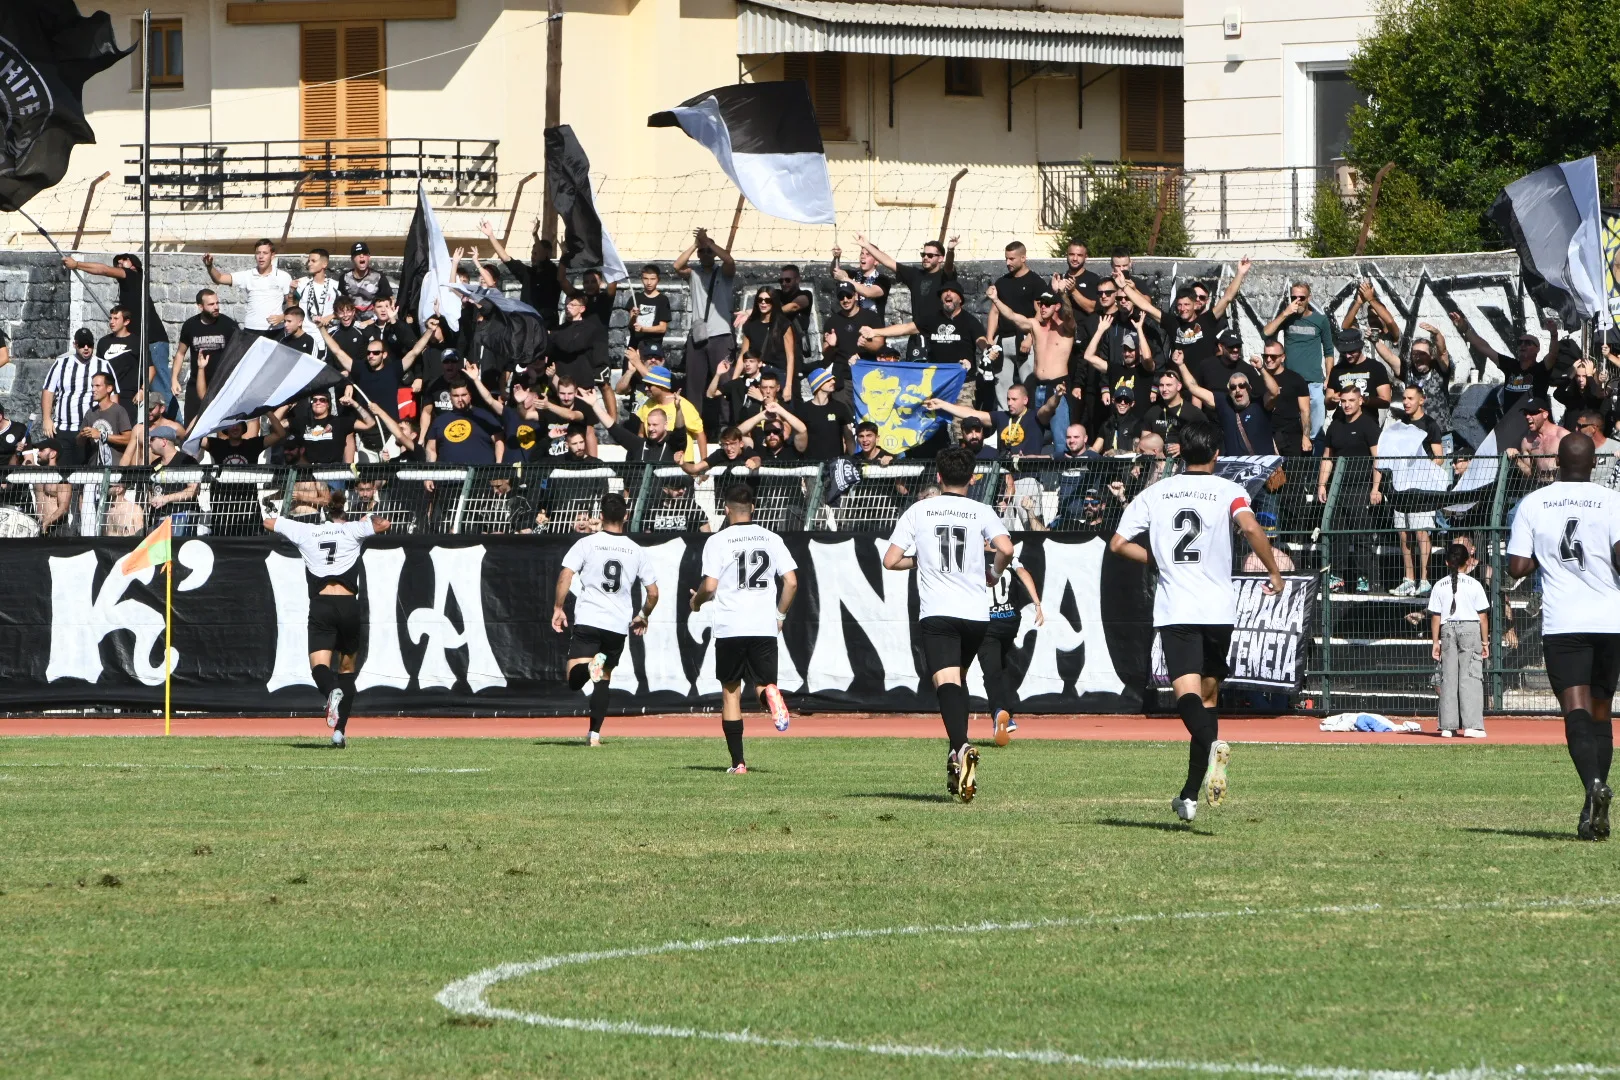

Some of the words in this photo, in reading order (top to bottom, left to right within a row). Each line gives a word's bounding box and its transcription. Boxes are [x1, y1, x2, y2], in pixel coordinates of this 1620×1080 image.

[0, 50, 41, 116] HITE
[318, 540, 338, 565] 7
[934, 524, 967, 573] 11
[1172, 508, 1202, 564] 2
[1558, 516, 1586, 571] 4
[601, 558, 623, 594] 9
[732, 548, 771, 590] 12
